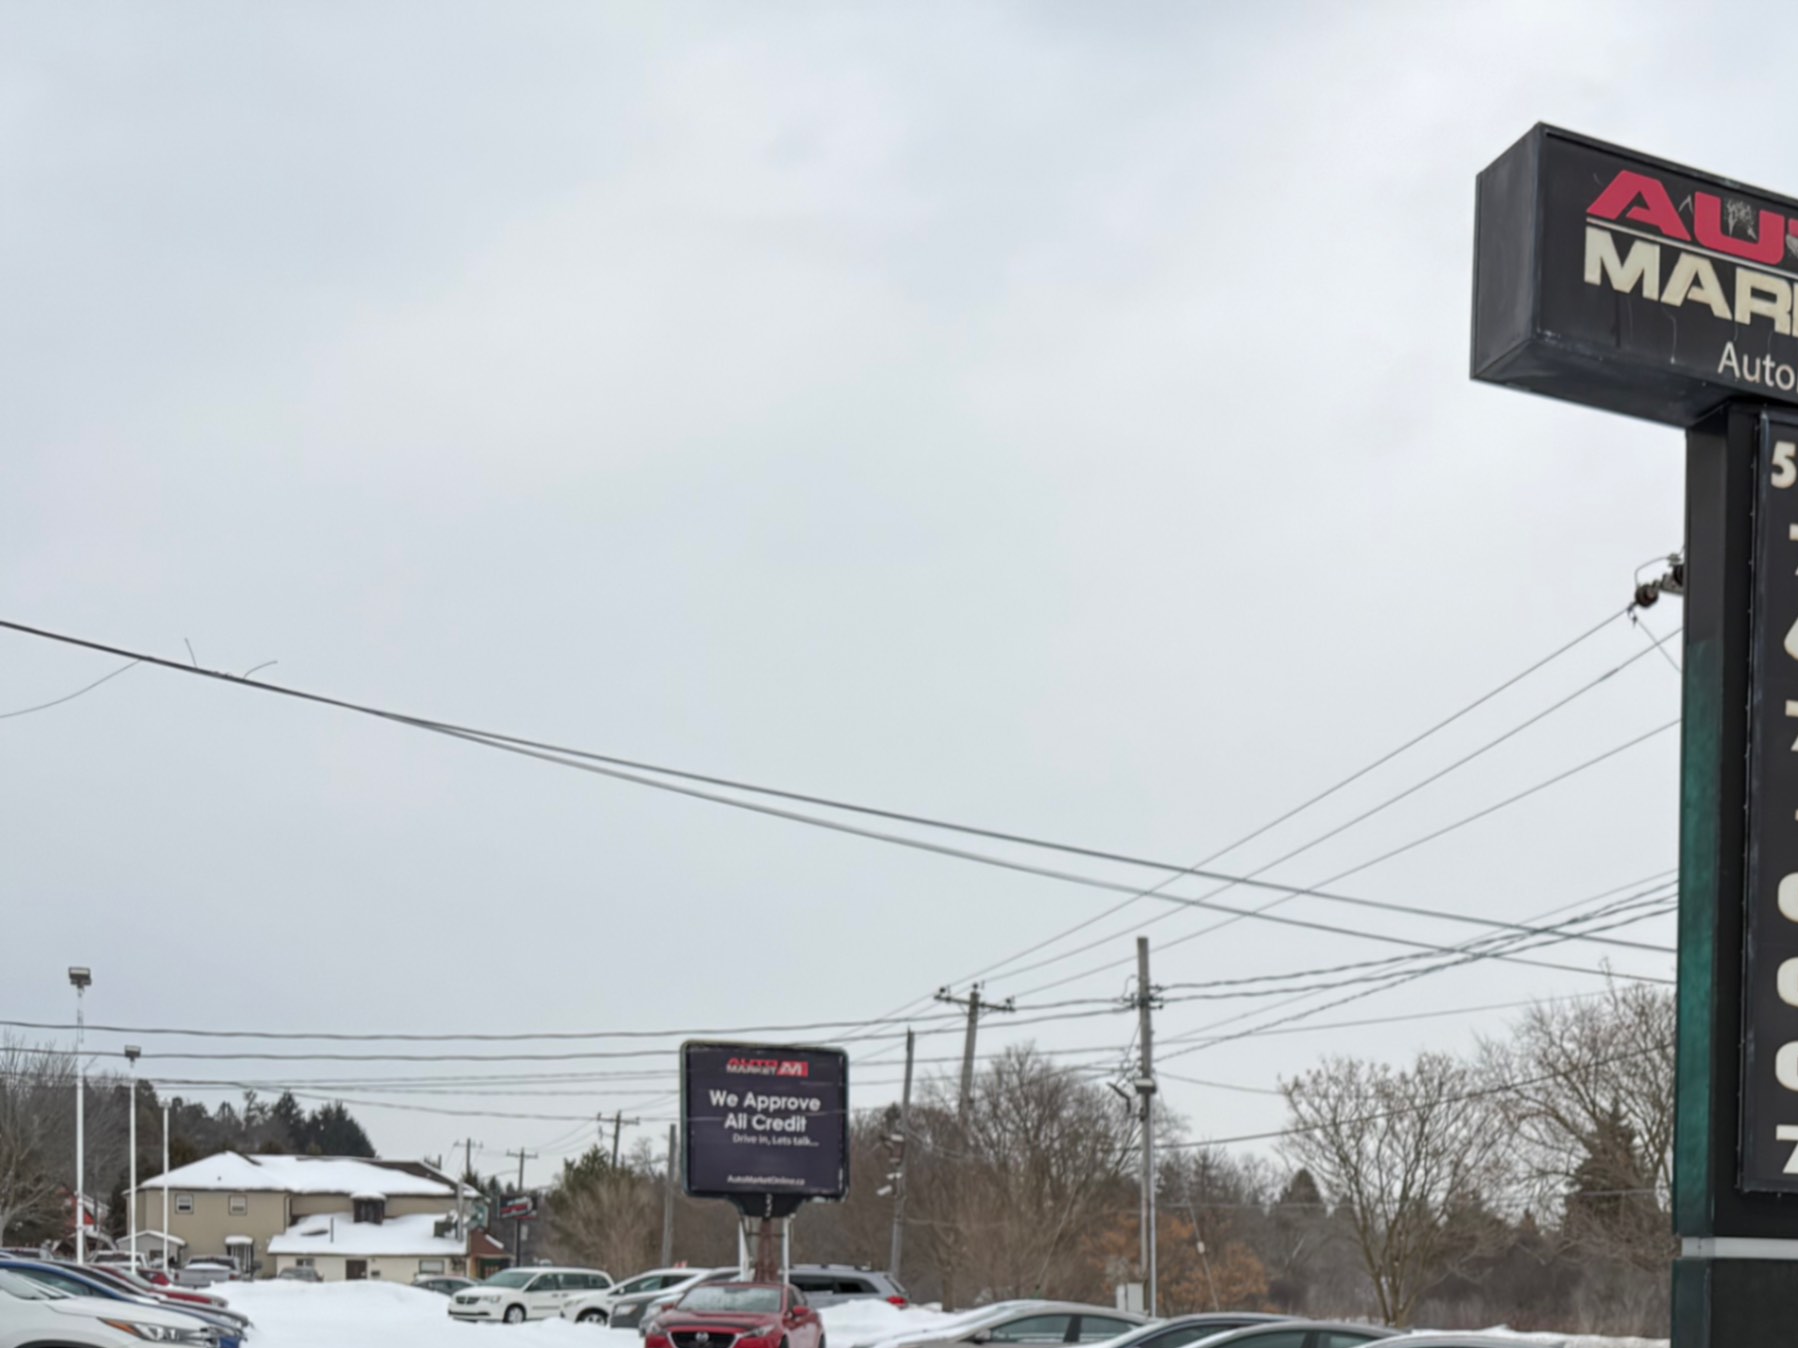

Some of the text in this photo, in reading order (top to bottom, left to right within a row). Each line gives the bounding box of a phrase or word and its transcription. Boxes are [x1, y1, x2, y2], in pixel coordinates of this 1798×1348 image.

[709, 1090, 821, 1112] We Approve
[724, 1113, 807, 1132] All Credit
[732, 1133, 757, 1144] Drive
[727, 1175, 806, 1187] AutoMarketOnline.ca
